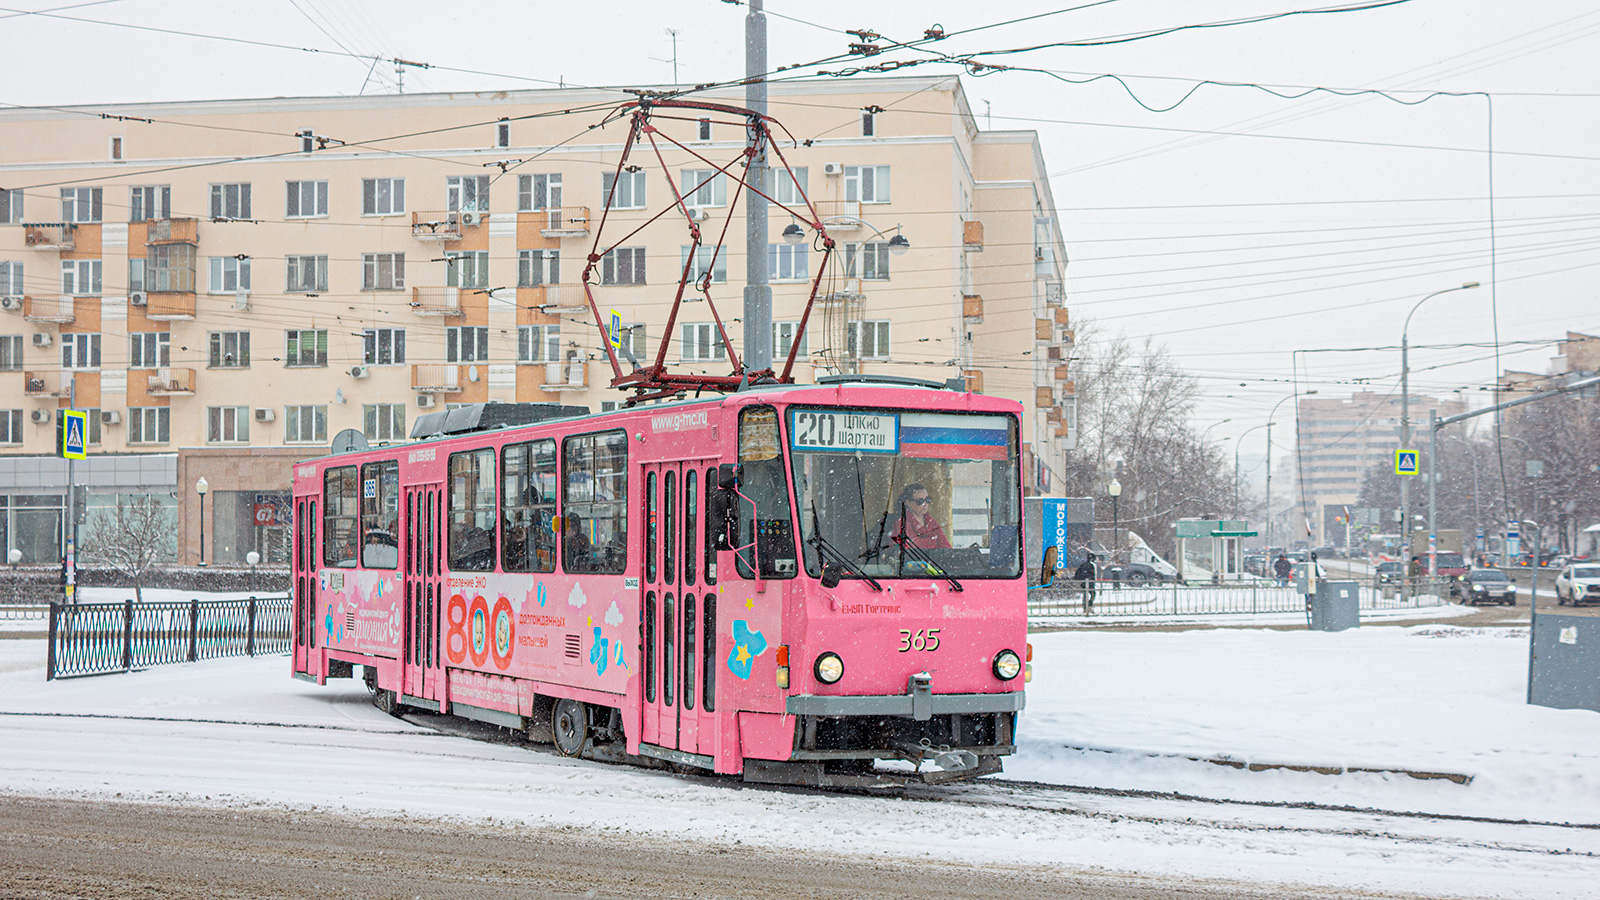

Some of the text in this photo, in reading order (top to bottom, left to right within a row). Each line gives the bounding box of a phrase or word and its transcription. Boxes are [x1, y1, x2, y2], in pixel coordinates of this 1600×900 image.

[651, 412, 707, 431] www.g-mc.ru
[798, 413, 835, 446] 20
[843, 415, 880, 430] ЦПКиО
[838, 431, 886, 448] Шарташ
[365, 480, 375, 497] 365
[446, 576, 487, 589] отделение ЭКО
[519, 613, 566, 628] долгожданных
[446, 594, 515, 671] 800
[519, 634, 549, 648] малышей
[898, 628, 940, 652] 365
